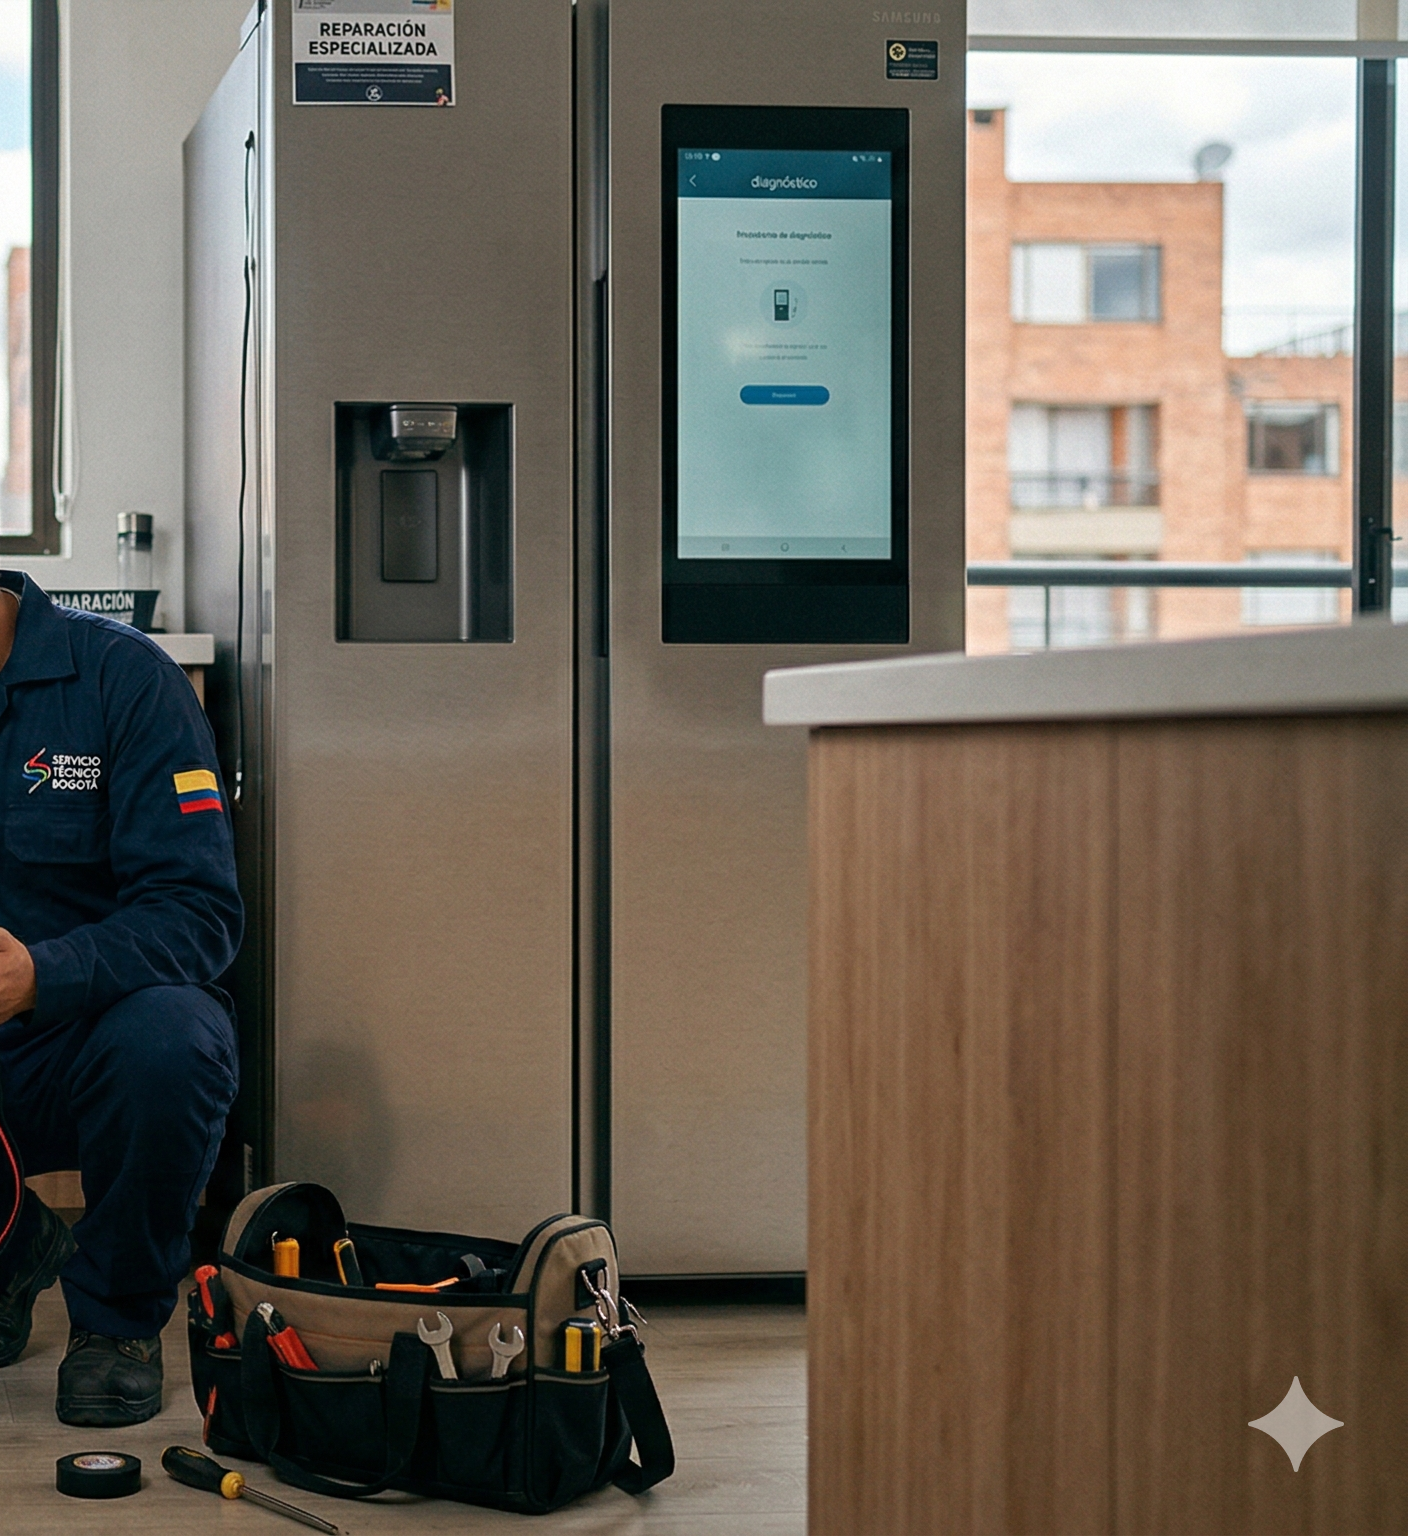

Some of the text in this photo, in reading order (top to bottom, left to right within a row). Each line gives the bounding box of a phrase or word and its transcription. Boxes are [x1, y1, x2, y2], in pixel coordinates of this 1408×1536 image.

[320, 19, 426, 37] REPARACIÓN
[309, 41, 438, 56] ESPECIALIZADA
[51, 754, 101, 766] SERVICIO
[53, 765, 101, 778] TÉCNICO
[52, 778, 98, 790] BOGOTÁ
